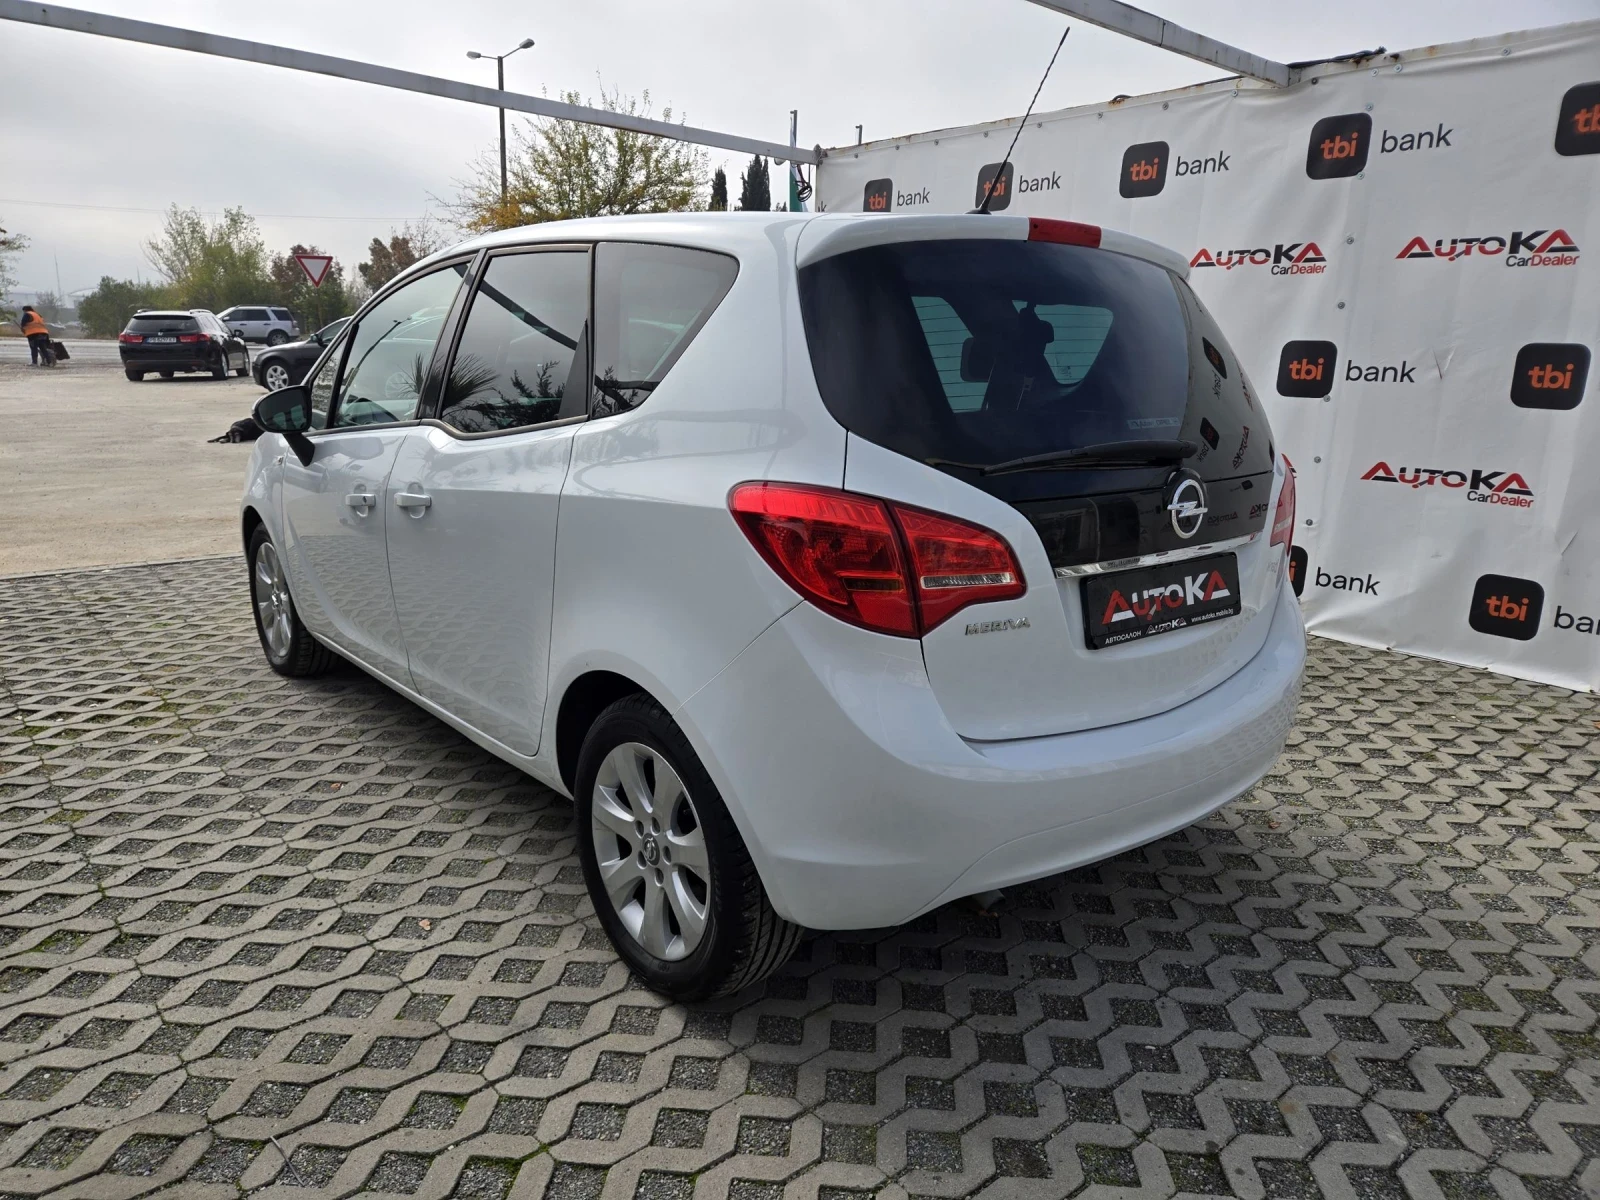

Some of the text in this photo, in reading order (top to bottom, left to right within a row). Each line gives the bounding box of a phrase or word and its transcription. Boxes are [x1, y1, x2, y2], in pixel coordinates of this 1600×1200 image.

[1574, 103, 1600, 133] tb
[1320, 123, 1453, 160] tbi bank
[1129, 151, 1231, 182] tbi bank
[1018, 171, 1061, 193] bank
[868, 187, 930, 210] tbi bank
[1271, 264, 1326, 275] CarDealer
[1506, 253, 1580, 267] CarDealer
[1289, 357, 1416, 383] tbi bank
[1528, 363, 1574, 390] tbi
[1466, 490, 1534, 508] CarDealer
[1315, 567, 1381, 596] bank
[1486, 595, 1529, 622] tbi
[965, 617, 1031, 636] MERIVA
[1105, 630, 1142, 645] АВТОСАЛОН
